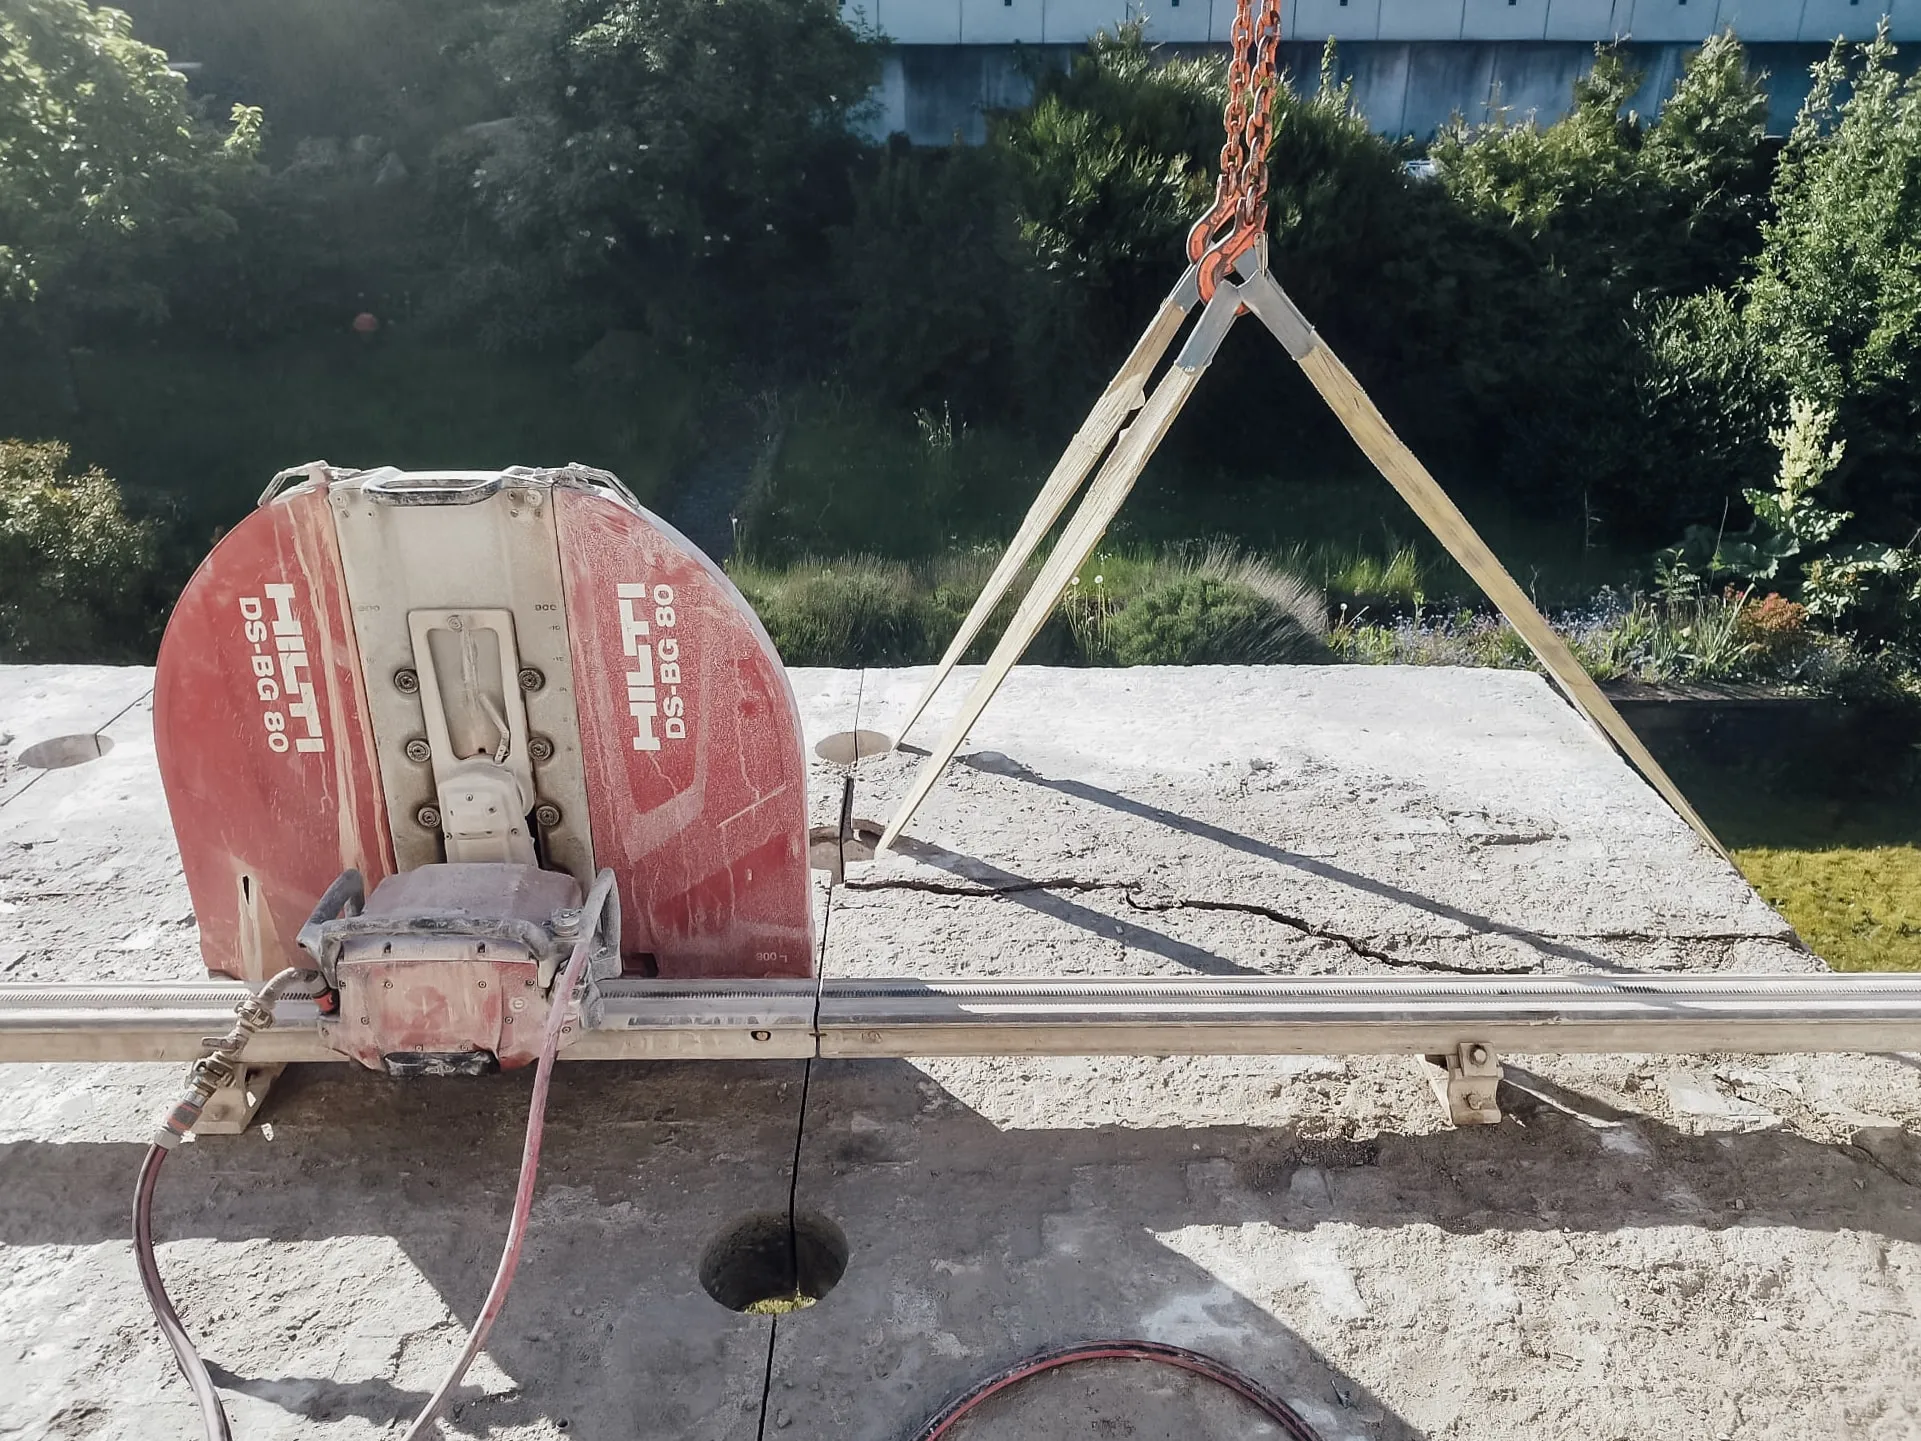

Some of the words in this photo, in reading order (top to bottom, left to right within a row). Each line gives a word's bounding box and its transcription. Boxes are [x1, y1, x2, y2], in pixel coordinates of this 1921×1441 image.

[239, 597, 279, 701] DS-BG
[264, 711, 289, 753] 80
[264, 583, 325, 752] HILTI
[617, 583, 661, 751] HILTI
[653, 584, 676, 628] 80
[658, 638, 686, 739] DS-BG
